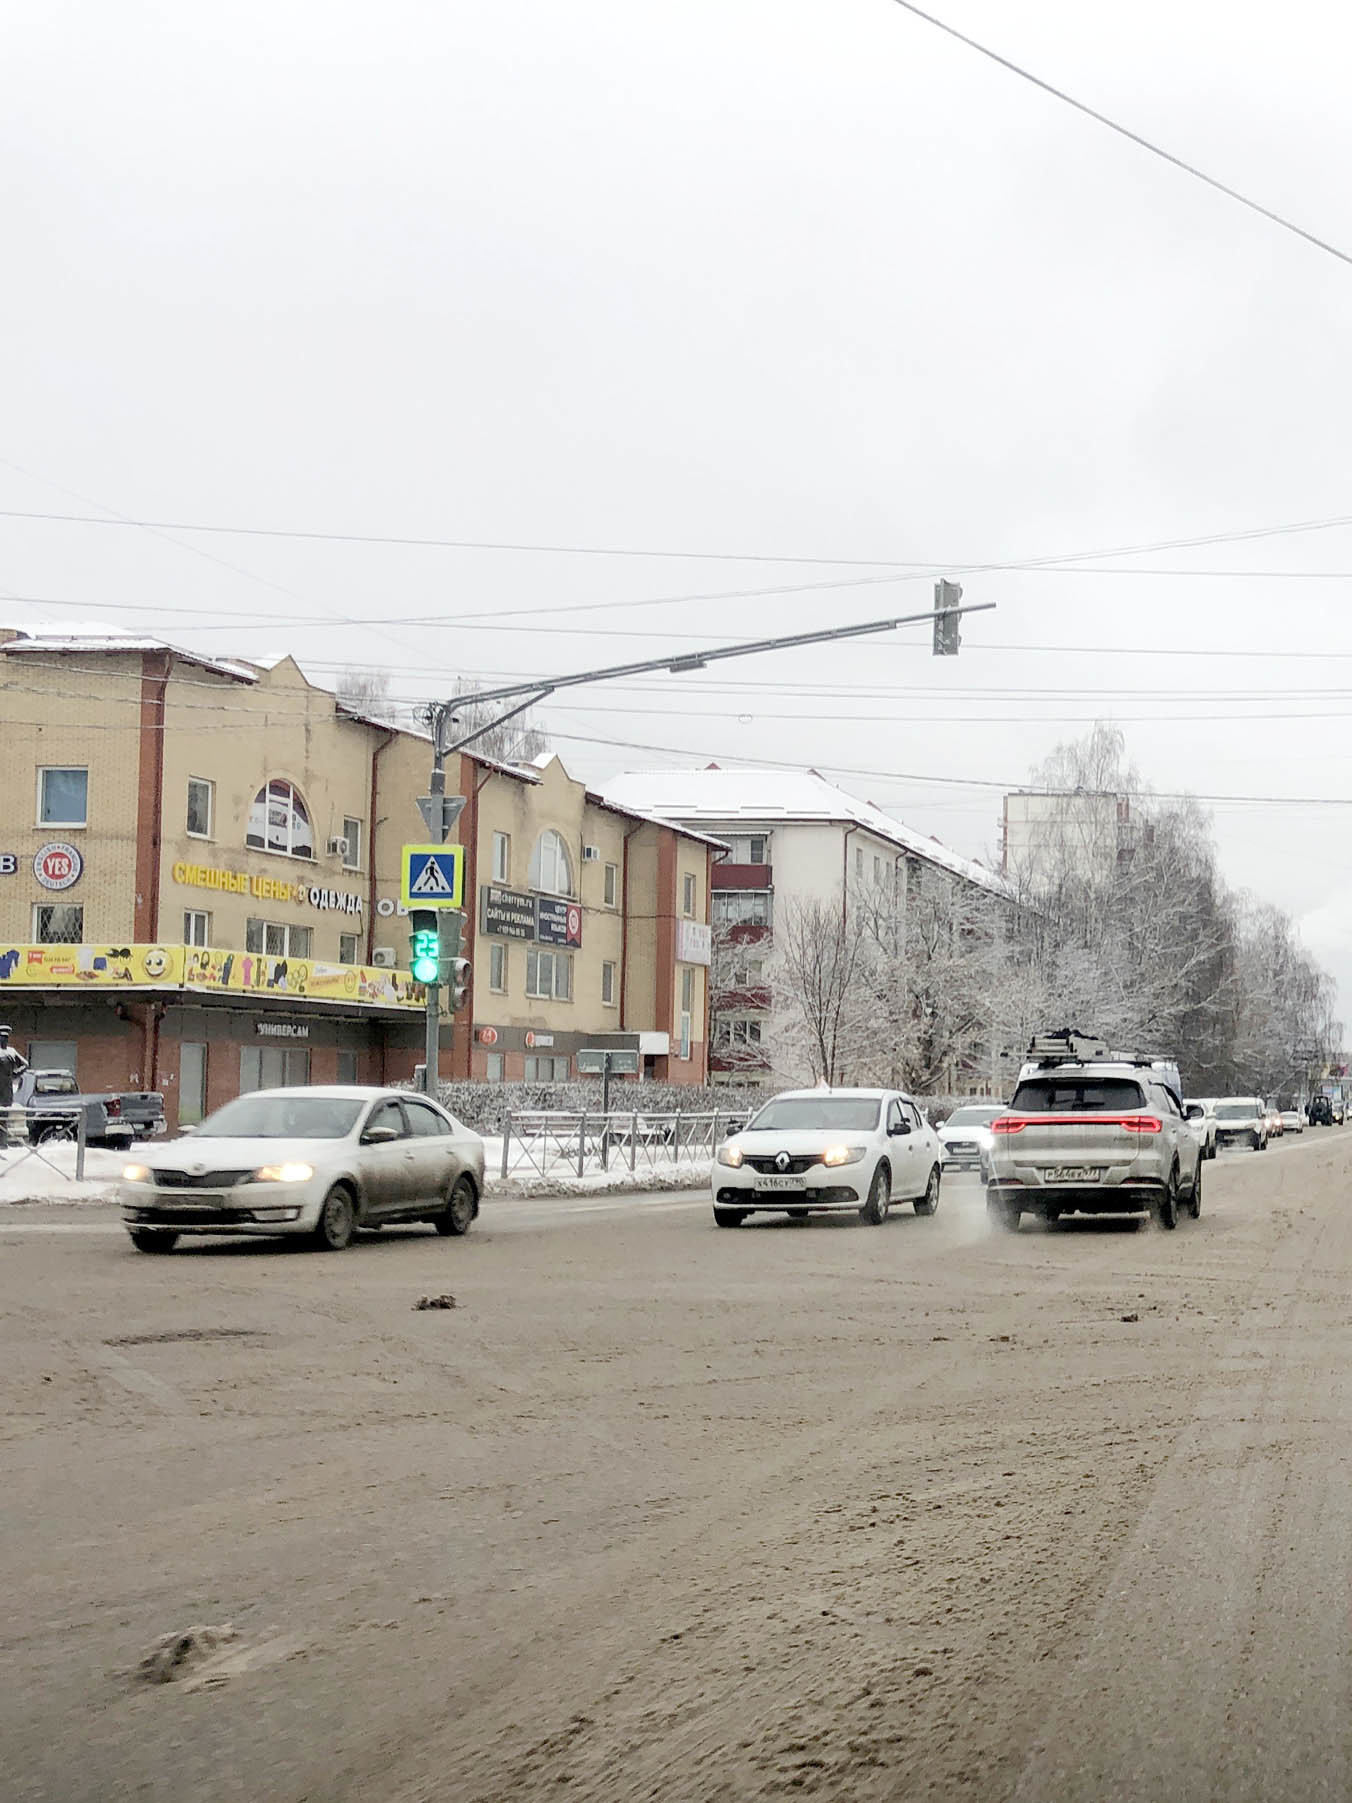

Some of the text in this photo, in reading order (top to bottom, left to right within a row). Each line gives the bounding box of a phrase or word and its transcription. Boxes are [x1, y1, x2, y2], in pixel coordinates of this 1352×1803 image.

[46, 857, 69, 875] YES
[173, 862, 364, 915] СМЕШНЫЕ ЦЕНЫ ОДЕЖДА
